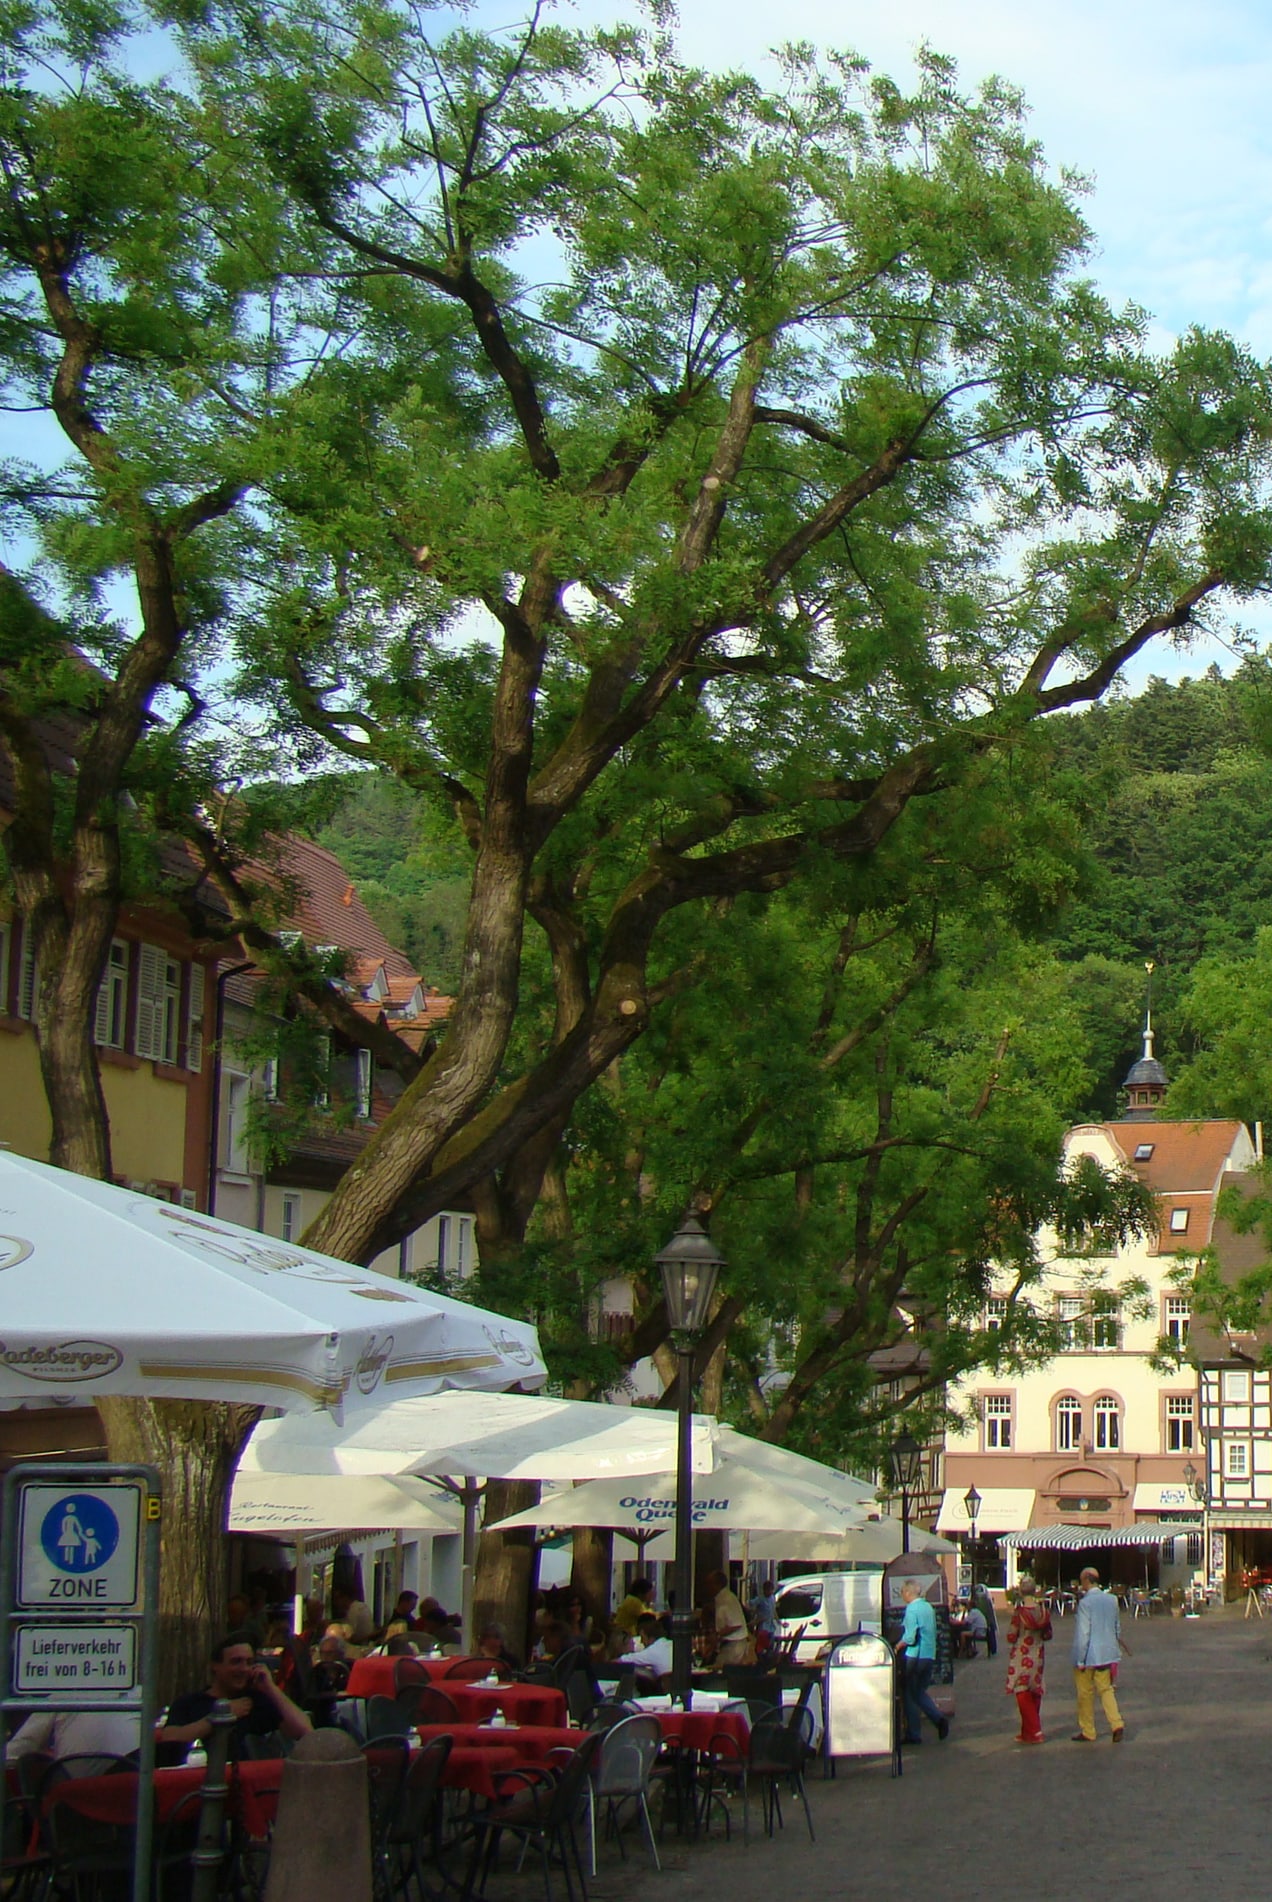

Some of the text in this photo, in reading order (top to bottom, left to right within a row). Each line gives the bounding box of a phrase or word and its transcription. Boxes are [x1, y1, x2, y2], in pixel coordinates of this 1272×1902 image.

[619, 1496, 729, 1510] Odenald
[635, 1508, 707, 1522] Quee
[49, 1579, 107, 1597] ZONE
[32, 1639, 122, 1655] Lieferverkehr
[25, 1662, 49, 1677] frei
[55, 1665, 77, 1676] von
